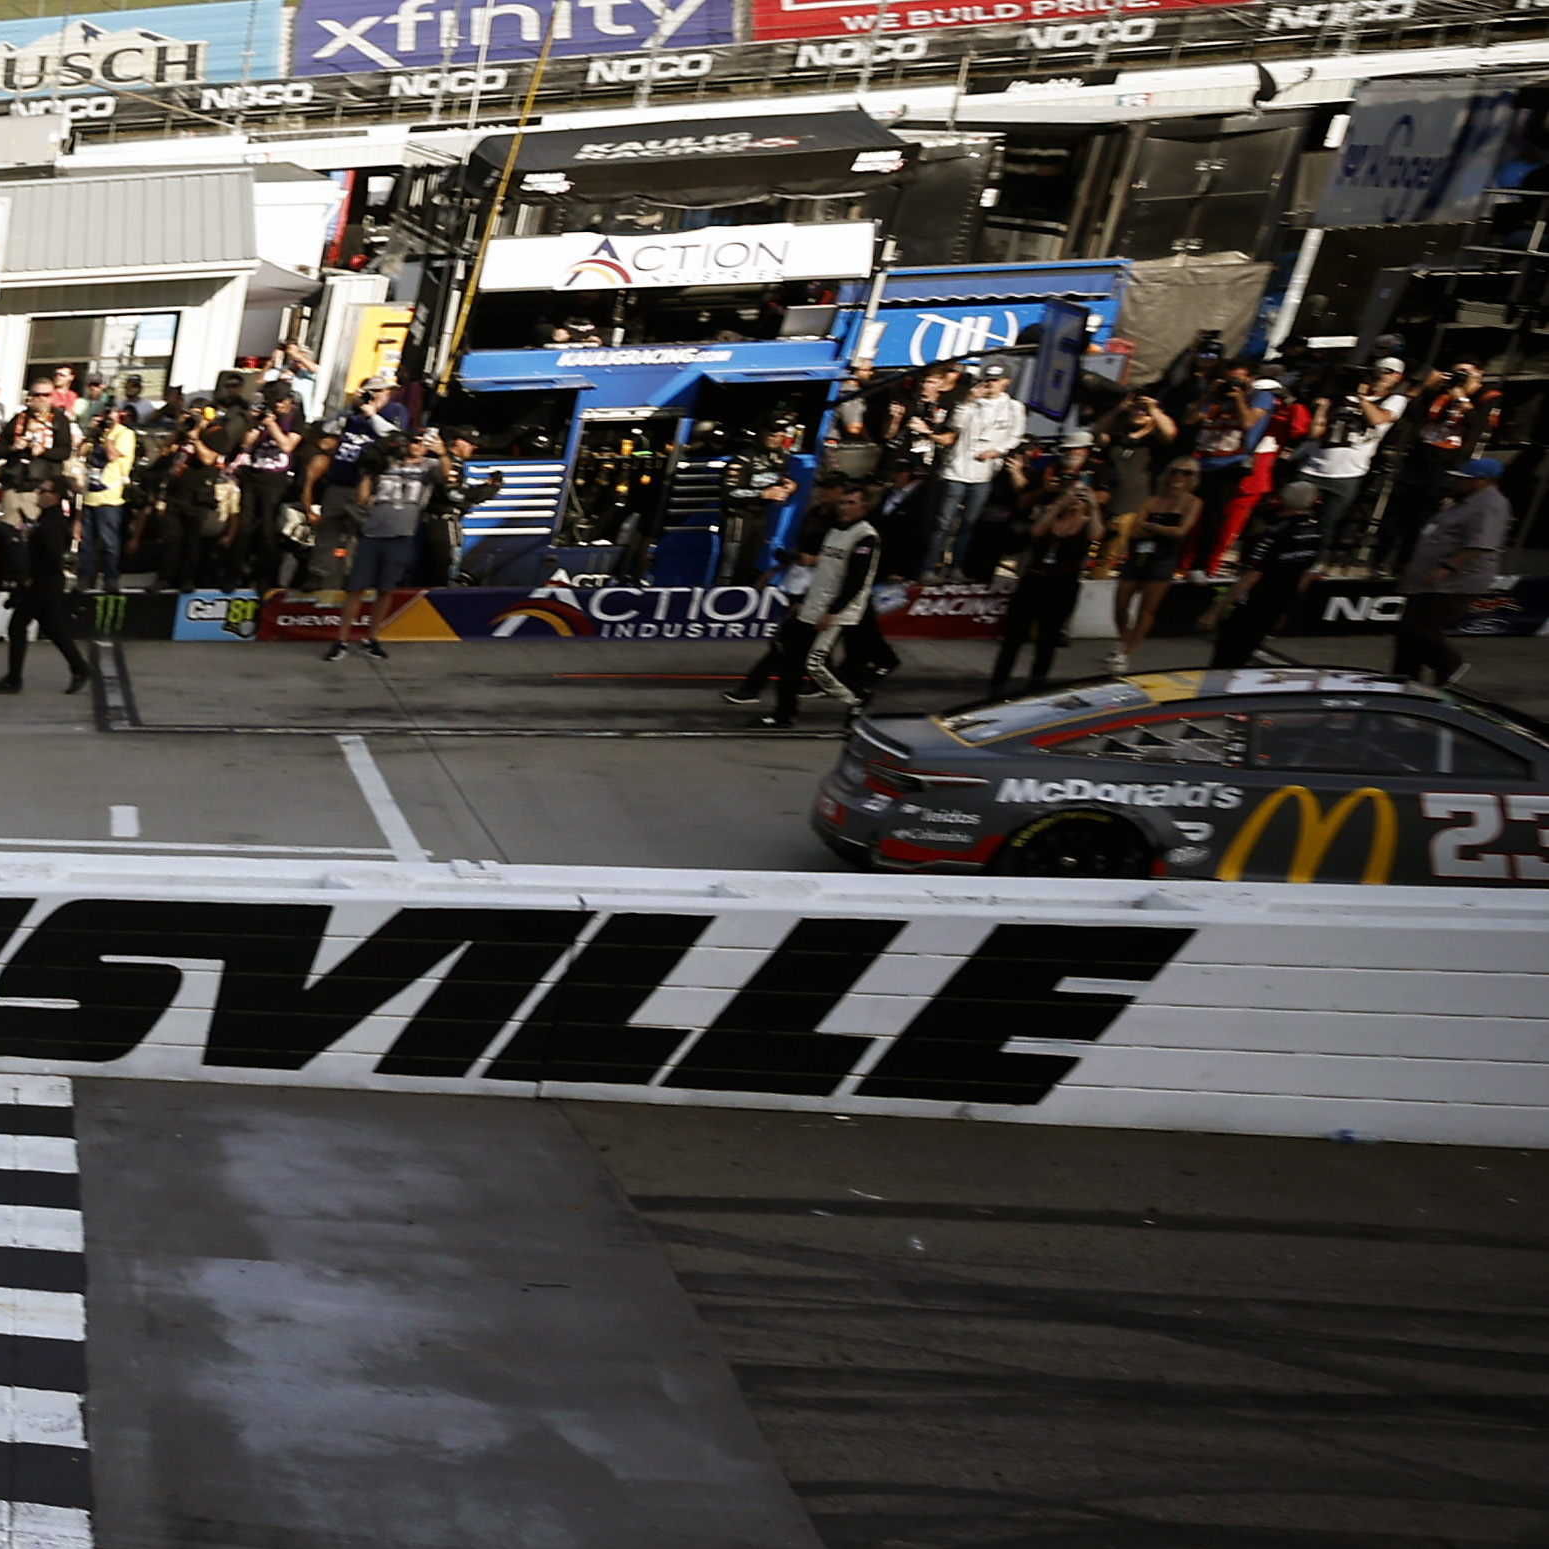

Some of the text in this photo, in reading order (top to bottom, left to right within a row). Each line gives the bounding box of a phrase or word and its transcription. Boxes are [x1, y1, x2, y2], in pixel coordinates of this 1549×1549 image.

[840, 12, 901, 32] WE
[908, 4, 1024, 27] BUILD
[312, 0, 698, 68] xfinity
[1019, 19, 1156, 49] NOCO
[796, 38, 929, 68] NOCO
[389, 68, 508, 98] NOCO
[588, 53, 713, 84] NOCO
[202, 83, 314, 111] NOCO
[563, 237, 791, 286] ACTION
[276, 614, 374, 627] CHEVRLE
[603, 622, 780, 640] INDUSTRIE
[996, 777, 1245, 810] McDonald's
